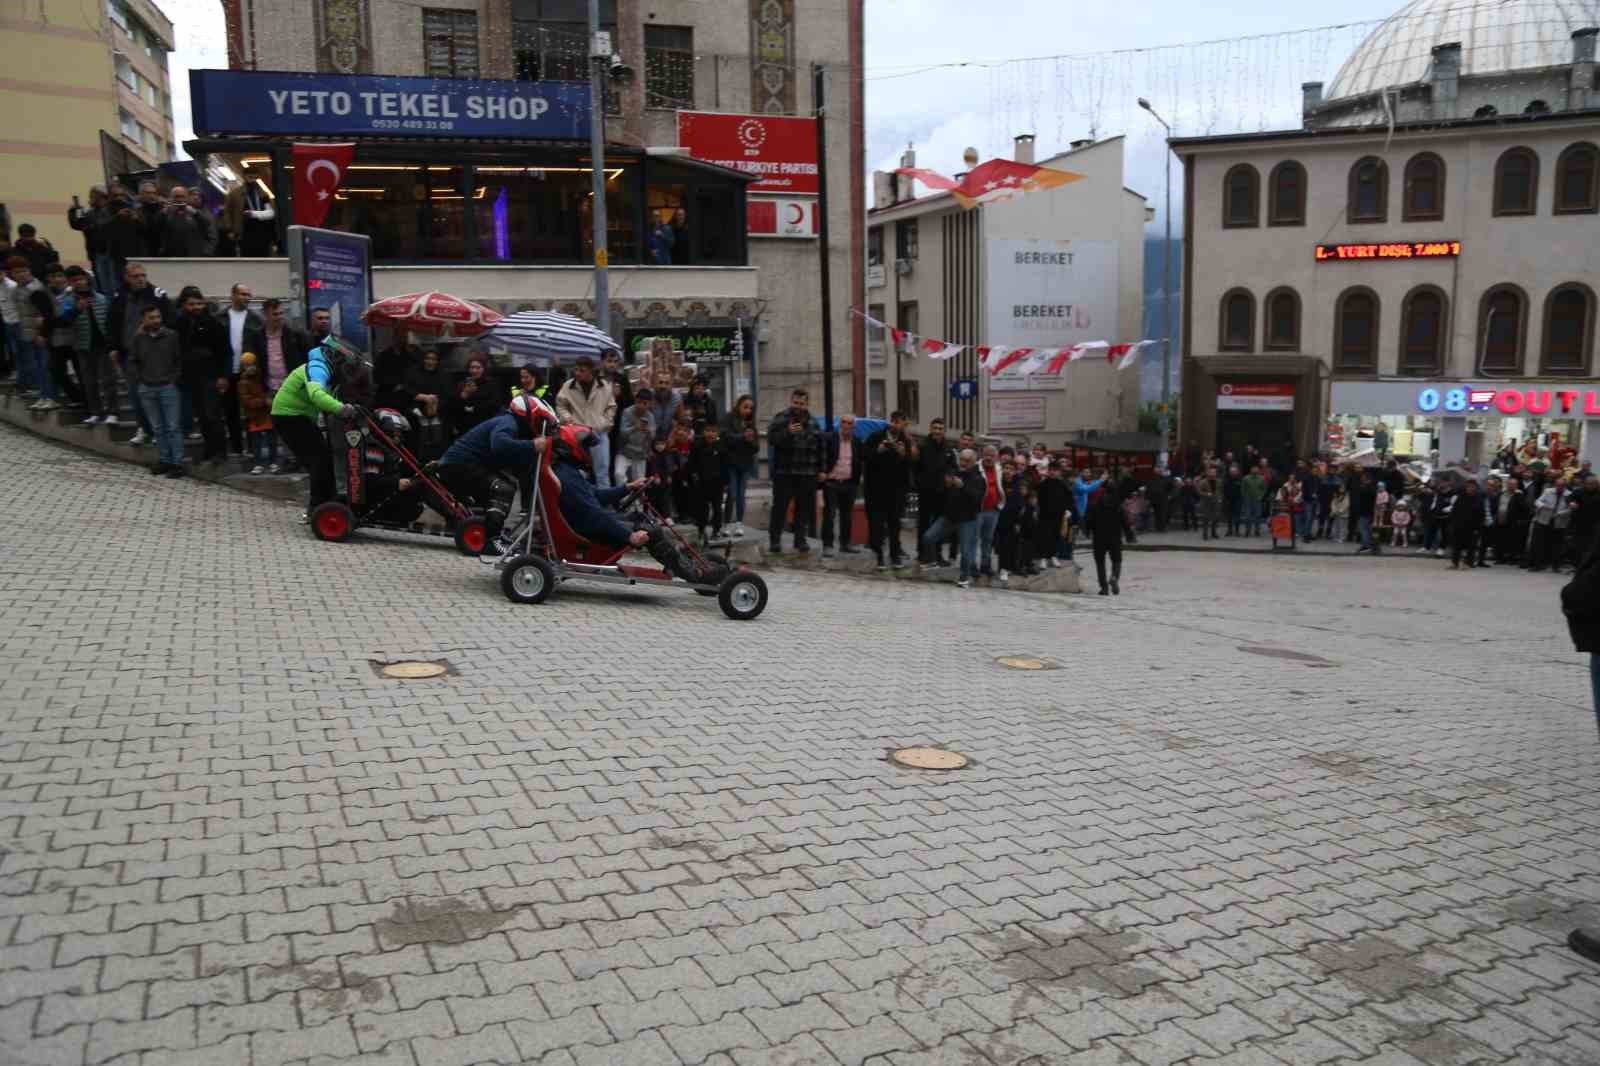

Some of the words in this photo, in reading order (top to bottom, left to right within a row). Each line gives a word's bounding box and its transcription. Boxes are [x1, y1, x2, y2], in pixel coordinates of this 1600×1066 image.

[268, 90, 351, 115] YETO
[359, 92, 459, 118] TEKEL
[466, 96, 549, 120] SHOP
[1337, 245, 1378, 258] YURT
[1015, 252, 1074, 265] BEREKET
[1013, 304, 1073, 317] BEREKET
[686, 335, 729, 349] Aktar
[1418, 388, 1467, 412] 08
[1495, 388, 1600, 414] OUTL
